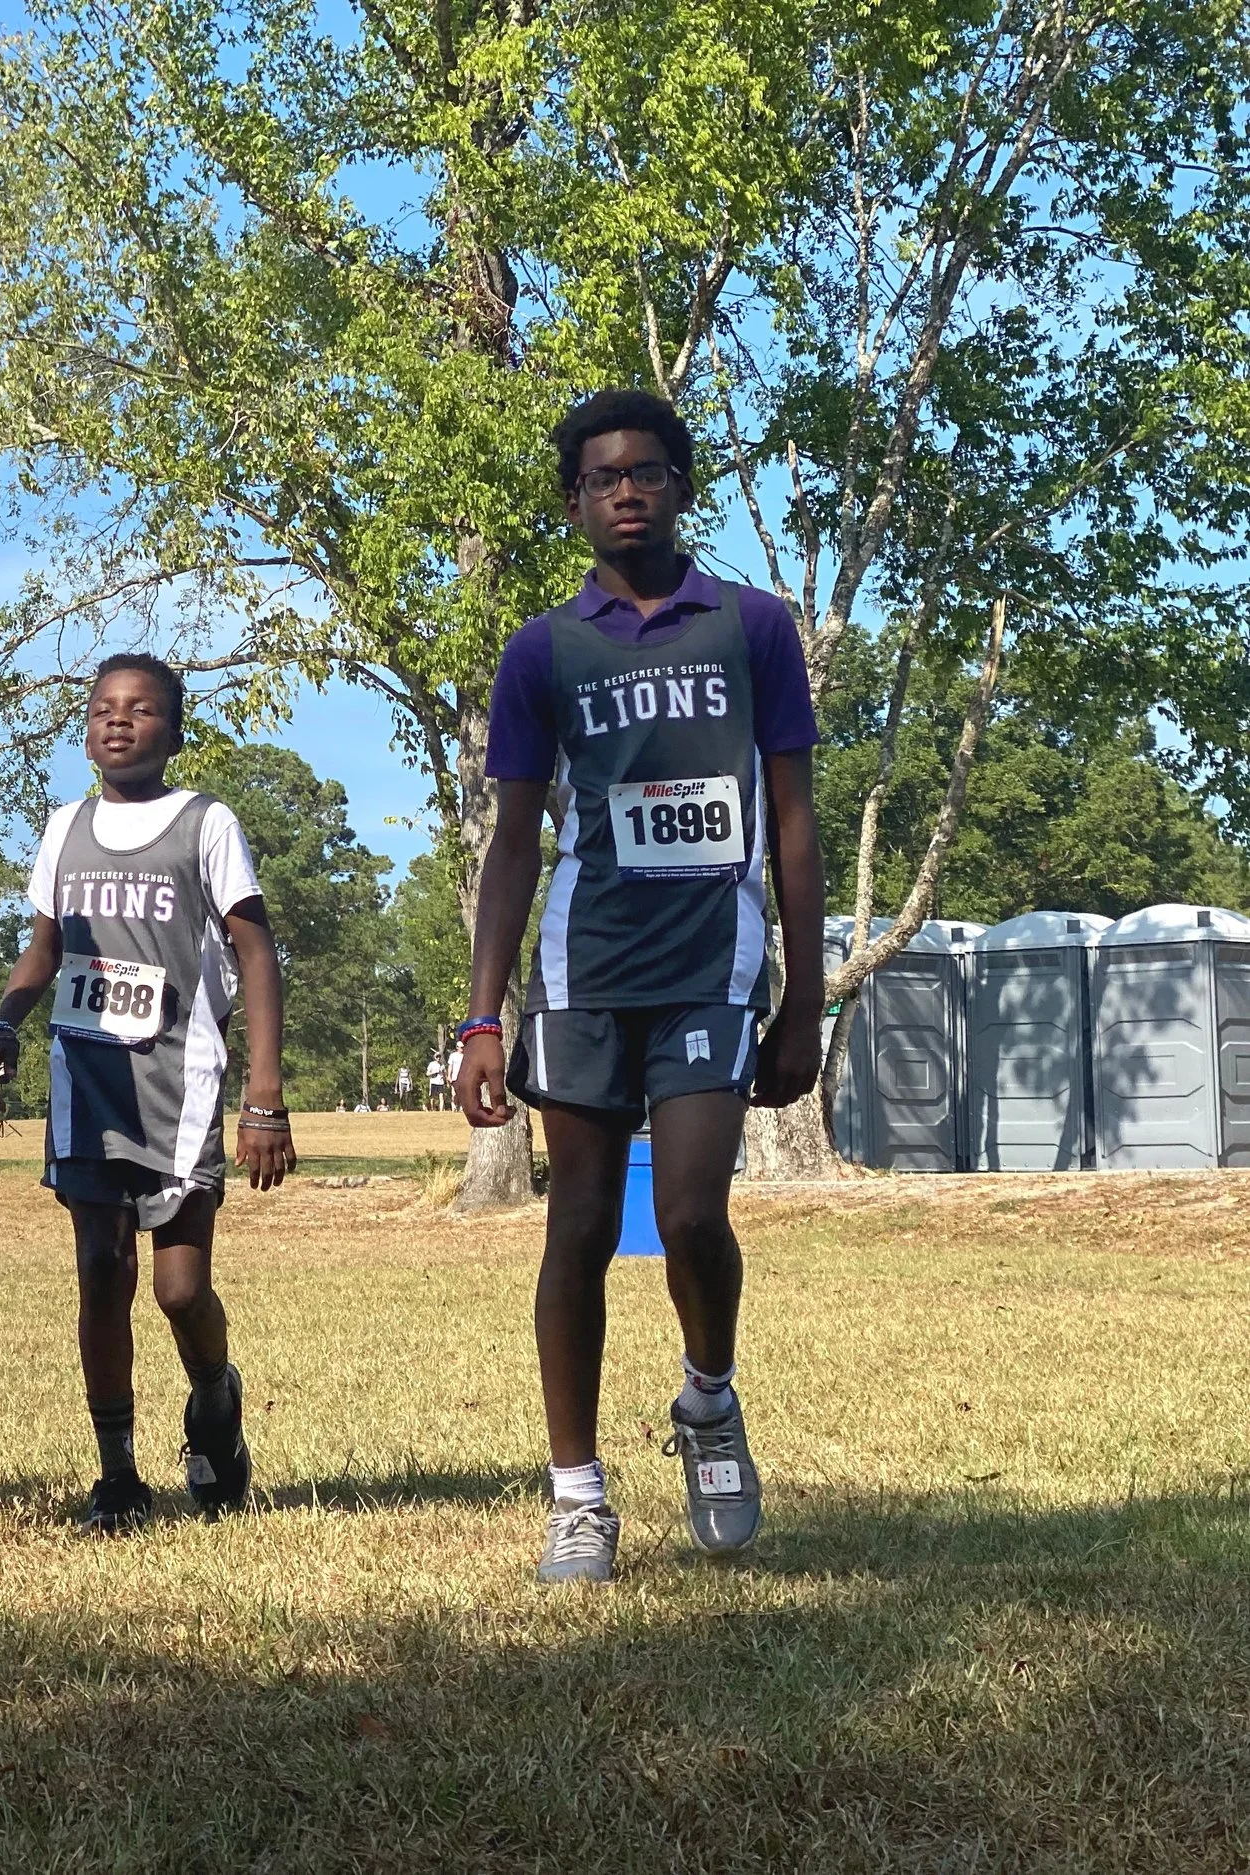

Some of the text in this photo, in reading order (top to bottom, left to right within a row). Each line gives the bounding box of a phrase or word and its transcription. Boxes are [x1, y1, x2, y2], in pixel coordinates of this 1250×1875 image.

[577, 663, 725, 694] THE REDEEMER'S SCHOOL
[578, 677, 727, 736] LIONS
[643, 782, 705, 798] MileSplit
[625, 800, 732, 846] 1899
[62, 882, 175, 922] LIONS
[89, 959, 140, 977] MileSplit
[70, 974, 155, 1020] 1898
